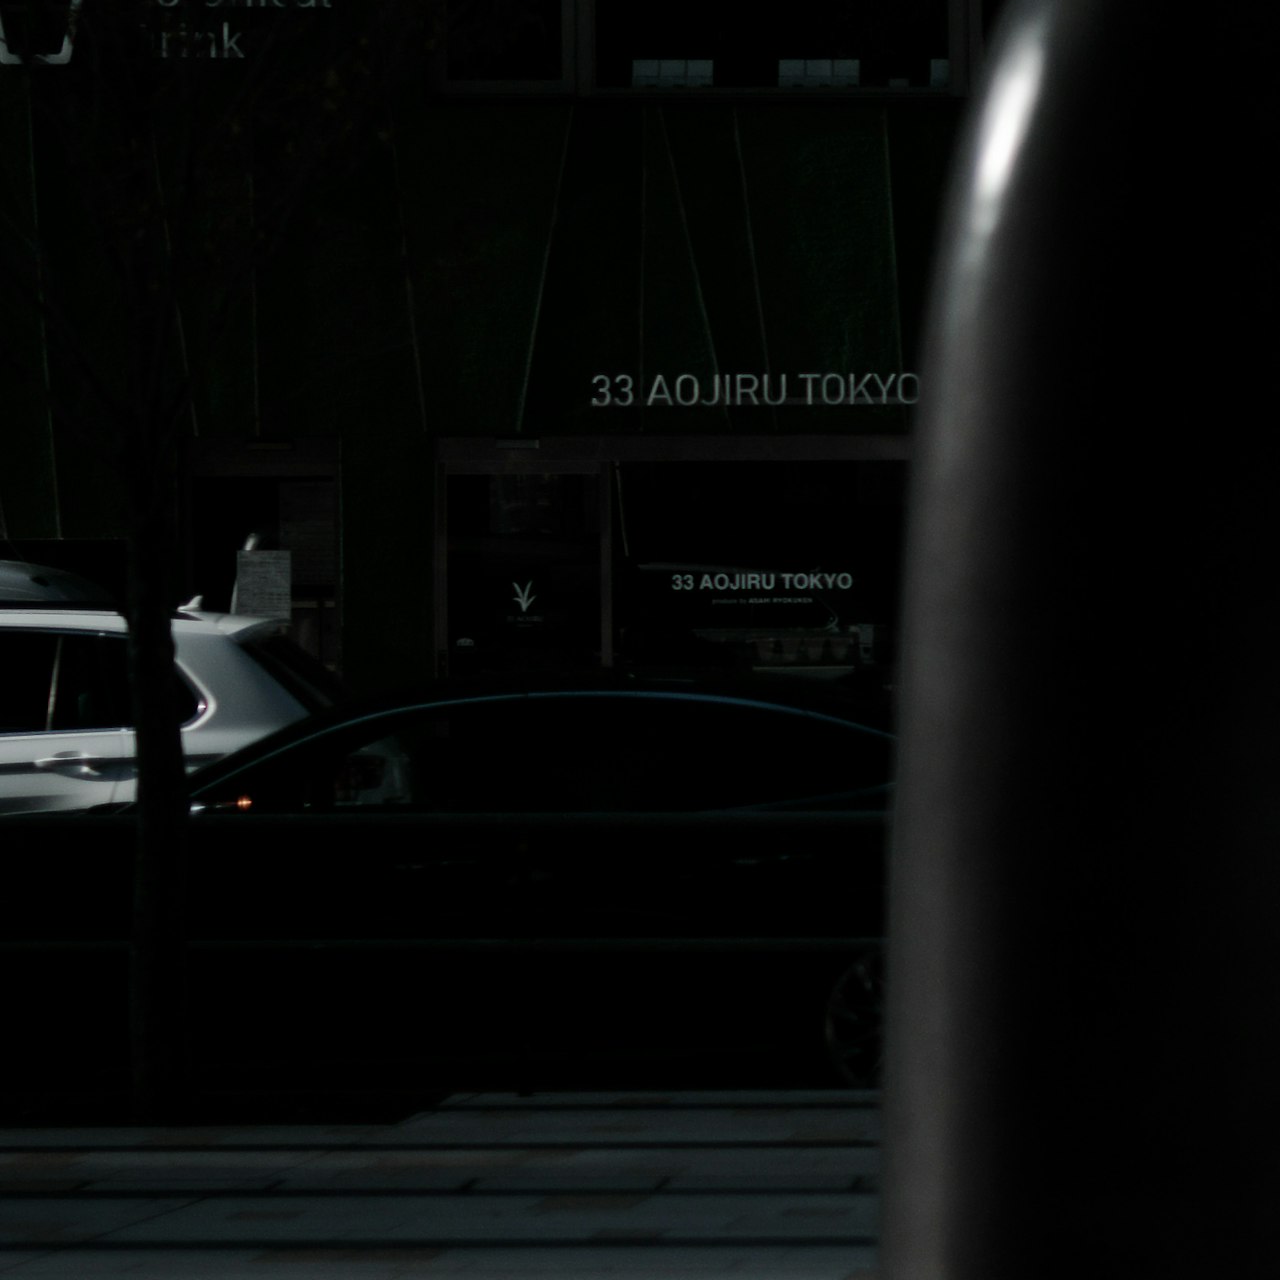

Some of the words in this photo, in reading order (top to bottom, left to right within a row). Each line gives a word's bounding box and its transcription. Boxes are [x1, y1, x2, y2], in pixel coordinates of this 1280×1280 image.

[590, 373, 635, 407] 33
[647, 373, 788, 407] AOJIRU
[797, 373, 921, 406] TOKYO
[671, 573, 695, 591] 33
[699, 572, 776, 591] AOJIRU
[781, 572, 854, 590] TOKYO
